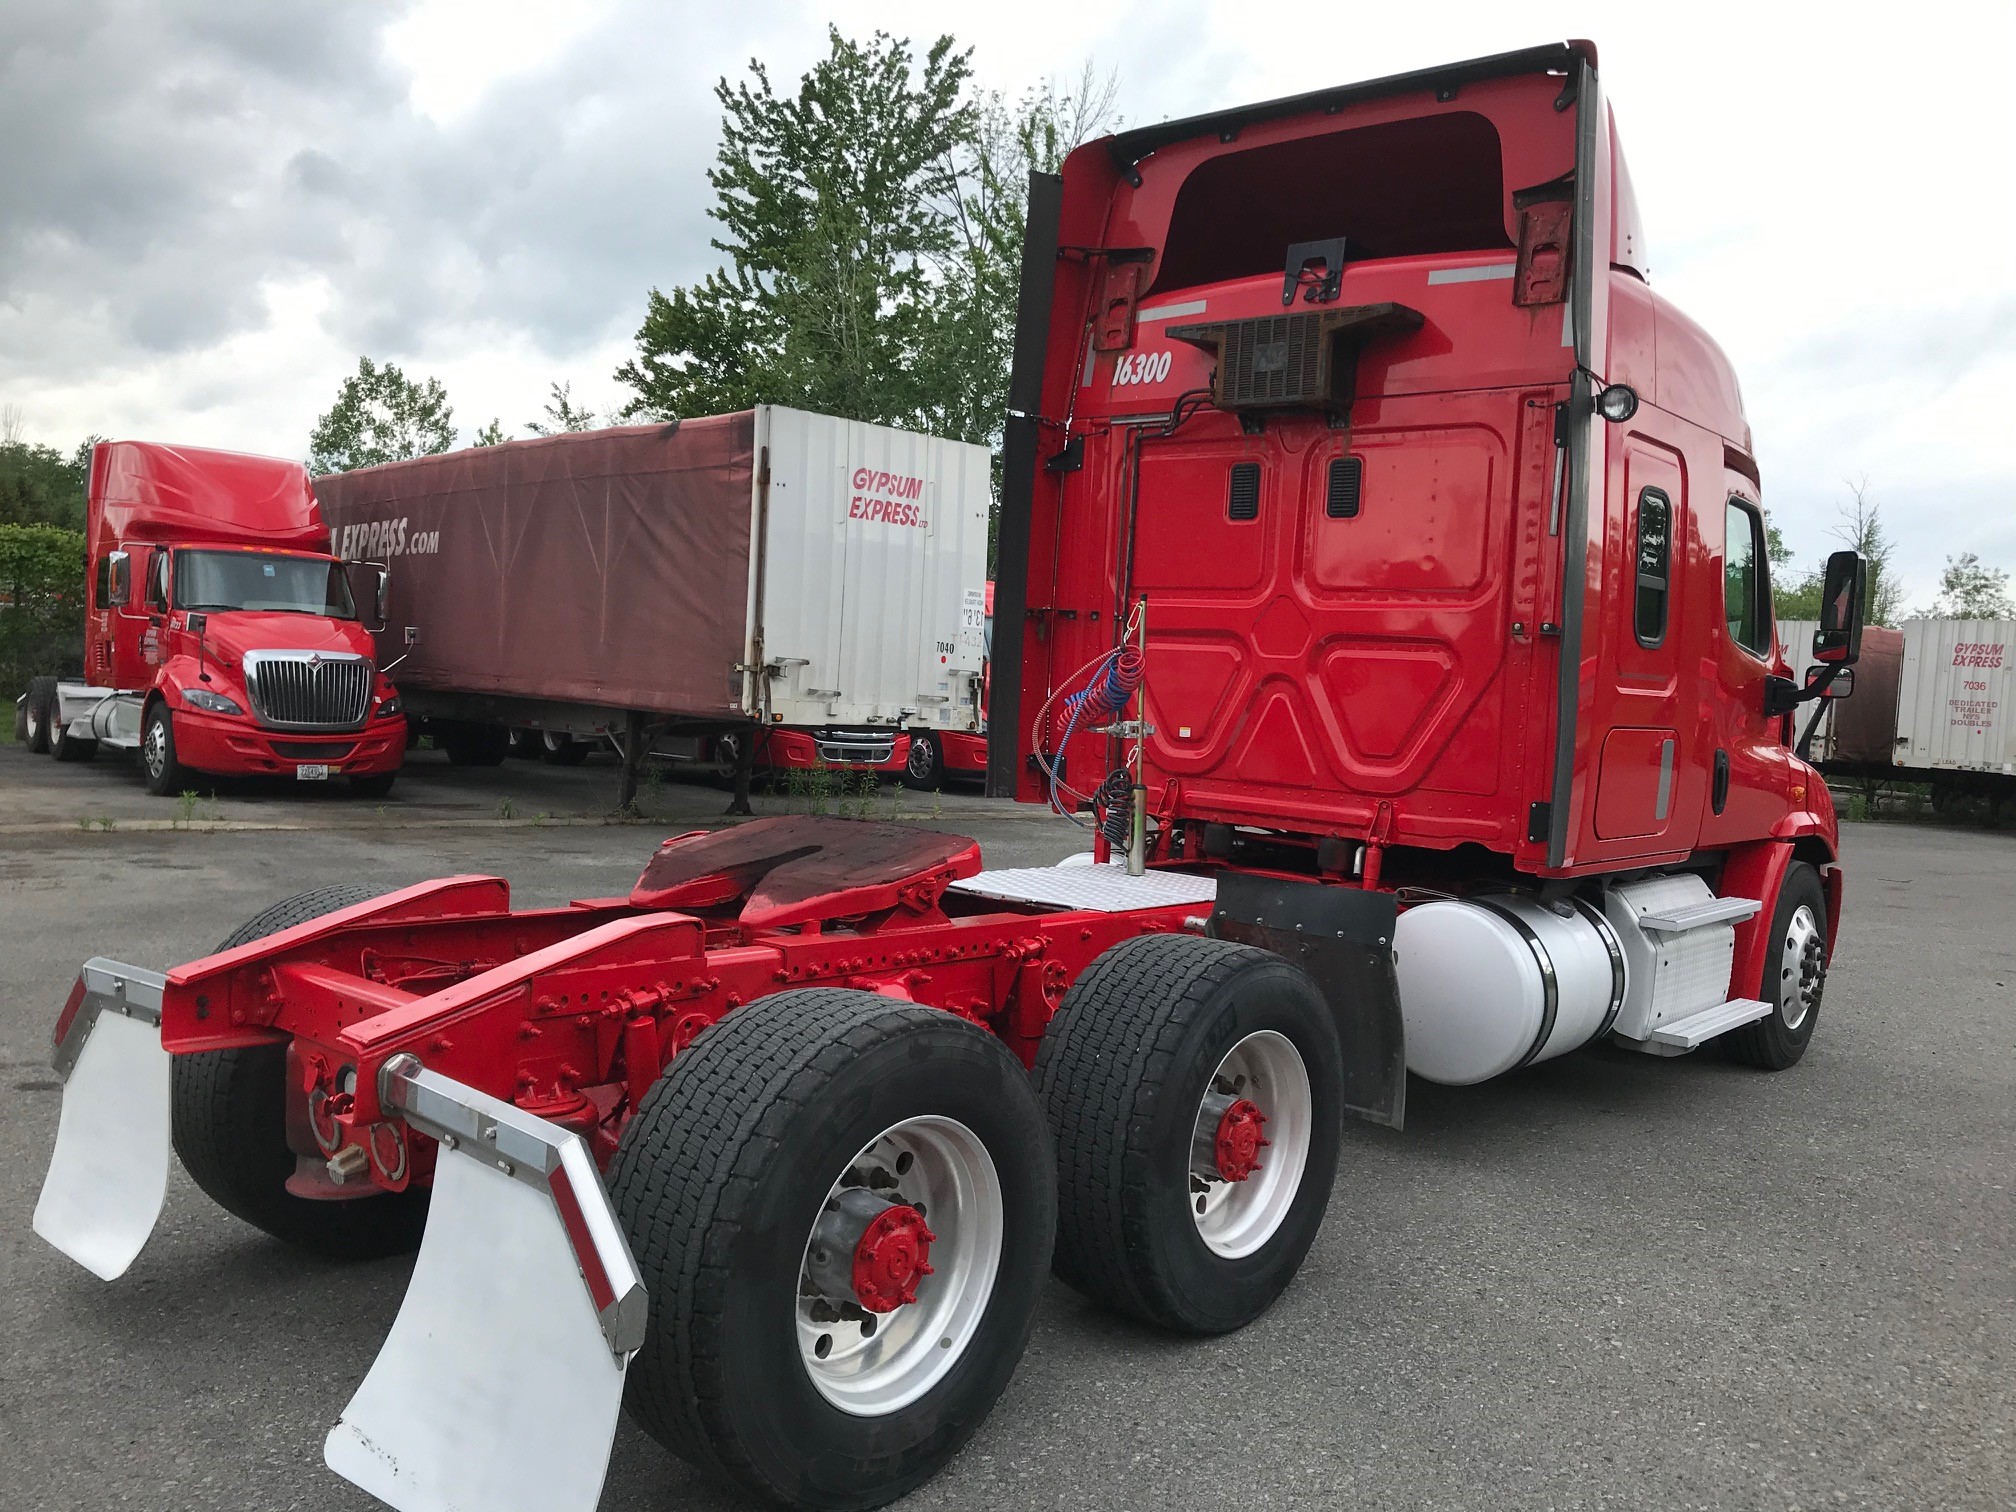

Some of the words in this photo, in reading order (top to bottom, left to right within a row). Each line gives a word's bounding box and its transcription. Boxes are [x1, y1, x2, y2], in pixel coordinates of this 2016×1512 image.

[1112, 351, 1172, 386] 16300
[852, 467, 923, 500] GYPSUM
[849, 496, 920, 527] EXPRESS
[936, 641, 955, 655] 7040
[1954, 643, 2004, 655] GYPSUM
[1952, 655, 2003, 668] EXPRESS
[1963, 681, 1986, 690] 7036
[1949, 700, 1998, 708] DEDICATED
[1951, 719, 1992, 727] DOUBLES
